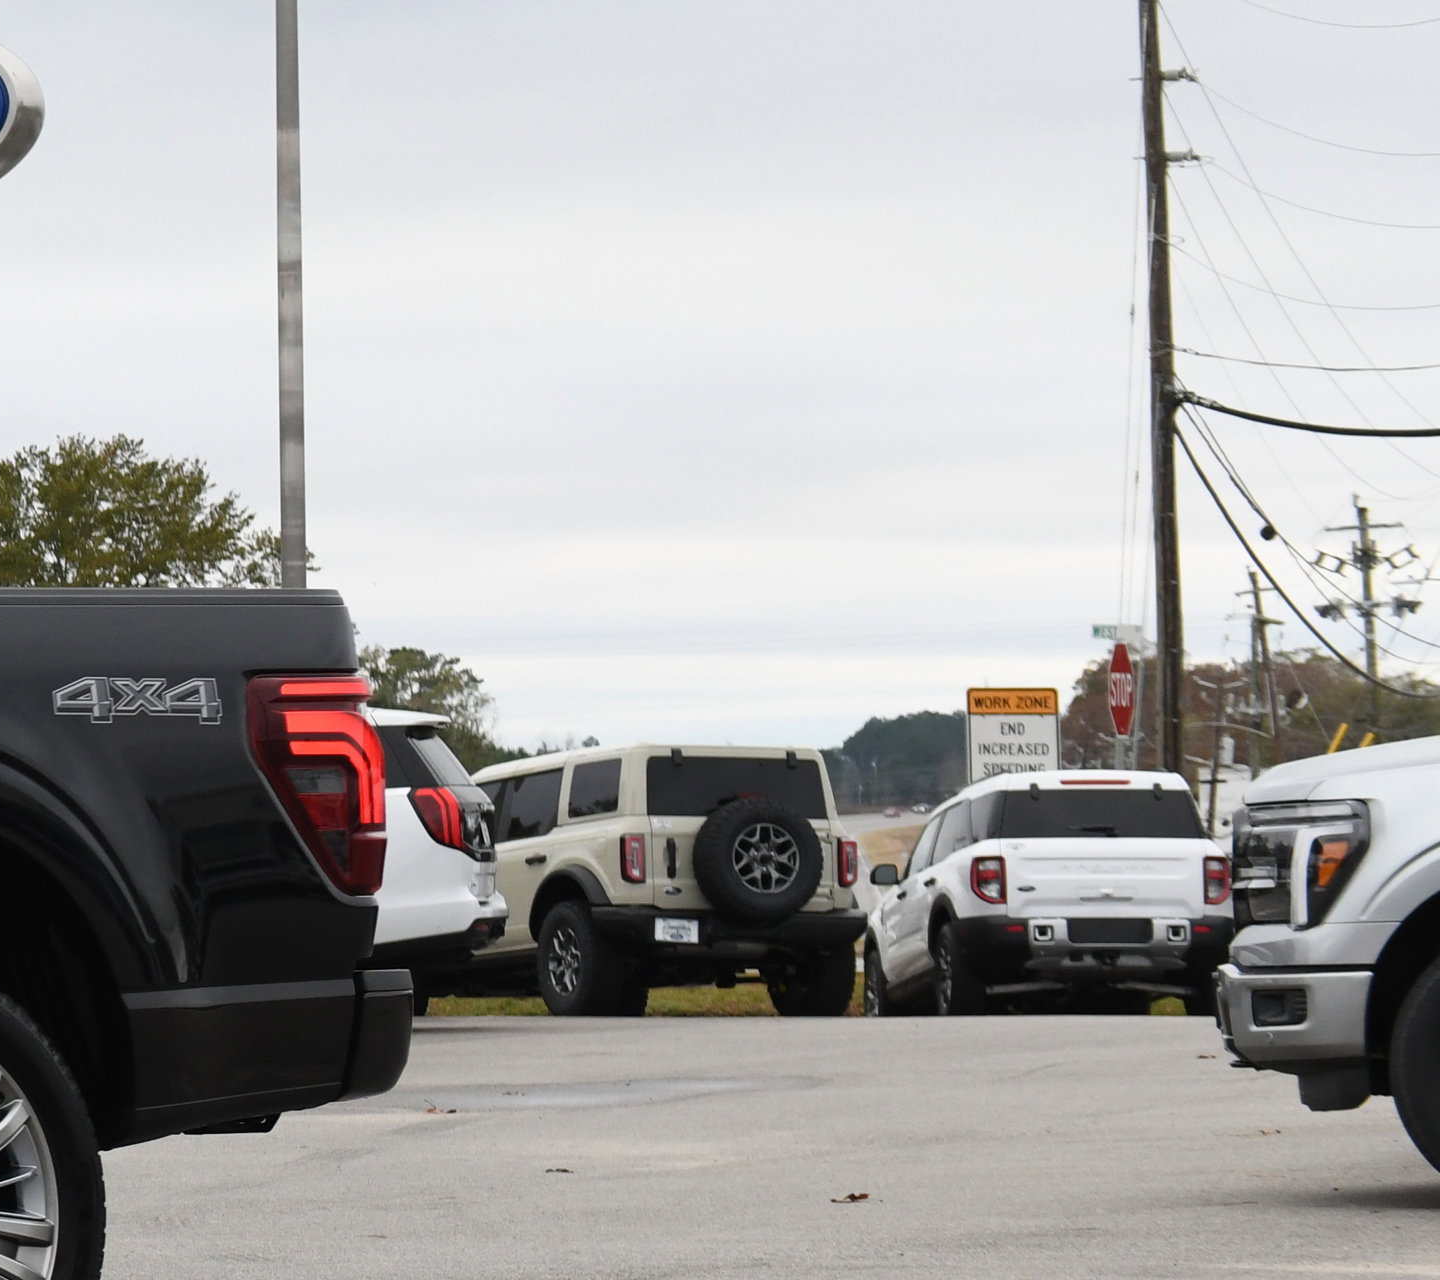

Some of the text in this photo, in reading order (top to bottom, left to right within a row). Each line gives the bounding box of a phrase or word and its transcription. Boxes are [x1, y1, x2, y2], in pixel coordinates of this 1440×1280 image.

[1110, 673, 1133, 707] STOP
[973, 696, 1052, 709] WORK ZONE
[1000, 722, 1026, 736] END
[978, 742, 1050, 757] INCREASED
